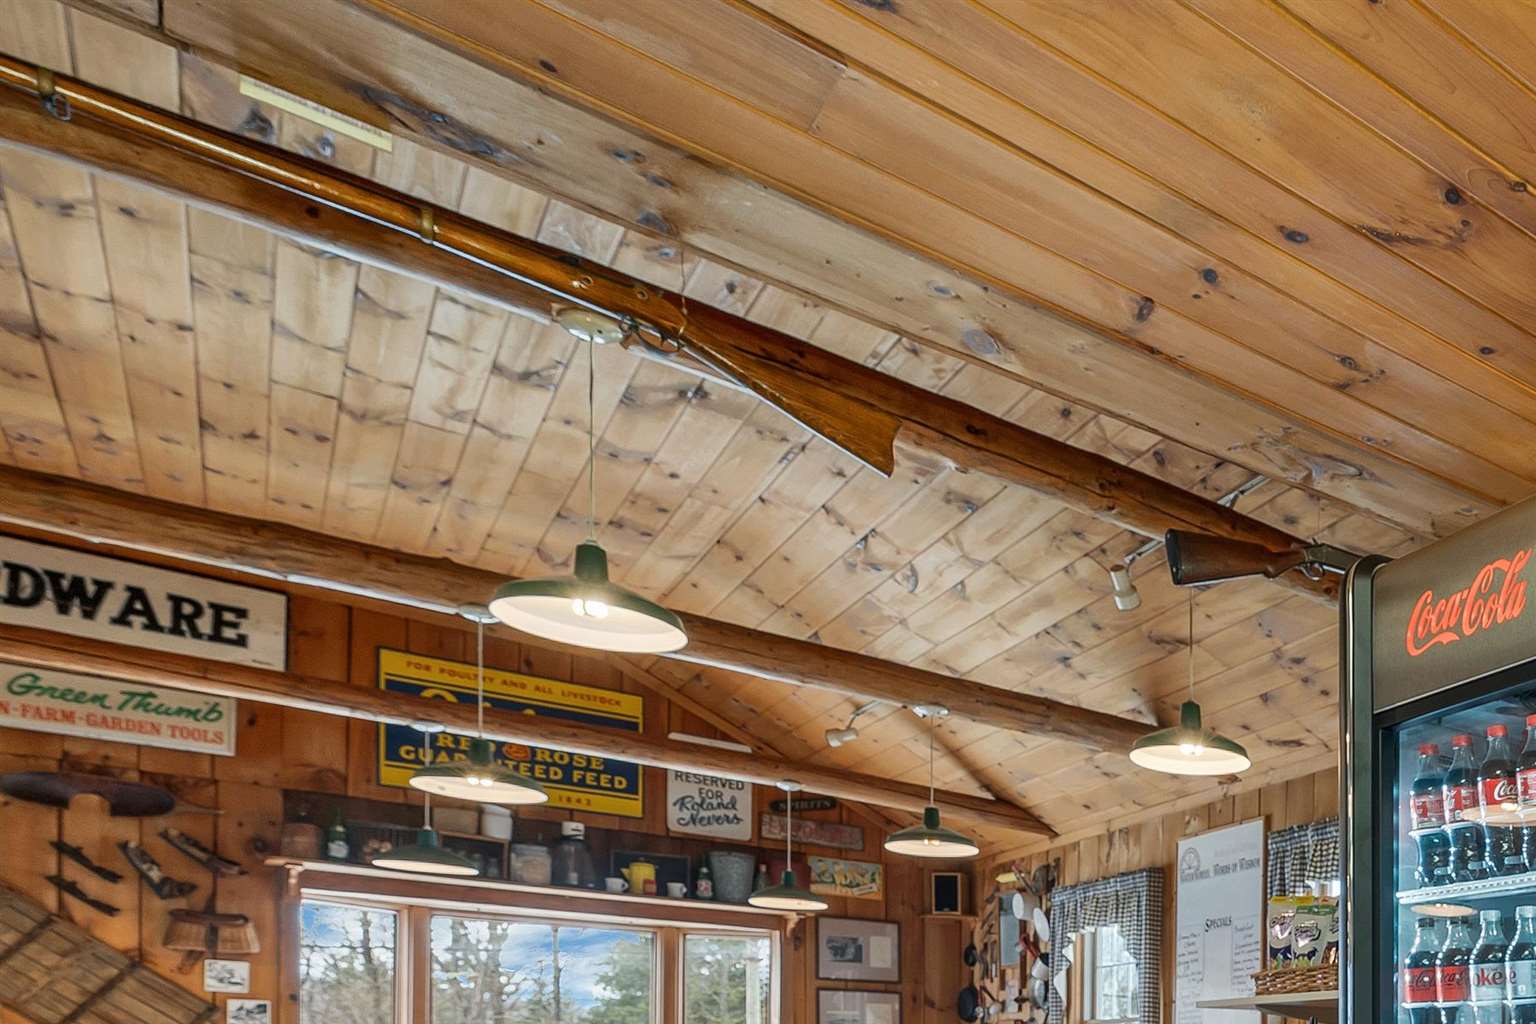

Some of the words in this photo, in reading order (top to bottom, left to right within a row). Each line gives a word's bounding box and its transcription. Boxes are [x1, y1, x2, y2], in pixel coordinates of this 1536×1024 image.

[0, 560, 249, 648] DWARE
[1406, 548, 1533, 656] Coca-Cola
[7, 672, 111, 709] Green
[118, 690, 223, 723] Thumb
[500, 679, 527, 690] AND
[560, 689, 622, 707] LIVESTOCK
[167, 724, 225, 745] TOOLS
[535, 748, 604, 770] ROSE
[571, 770, 628, 790] FEED
[673, 771, 746, 791] RESERVED
[672, 794, 738, 814] Roland
[697, 787, 724, 801] FOR
